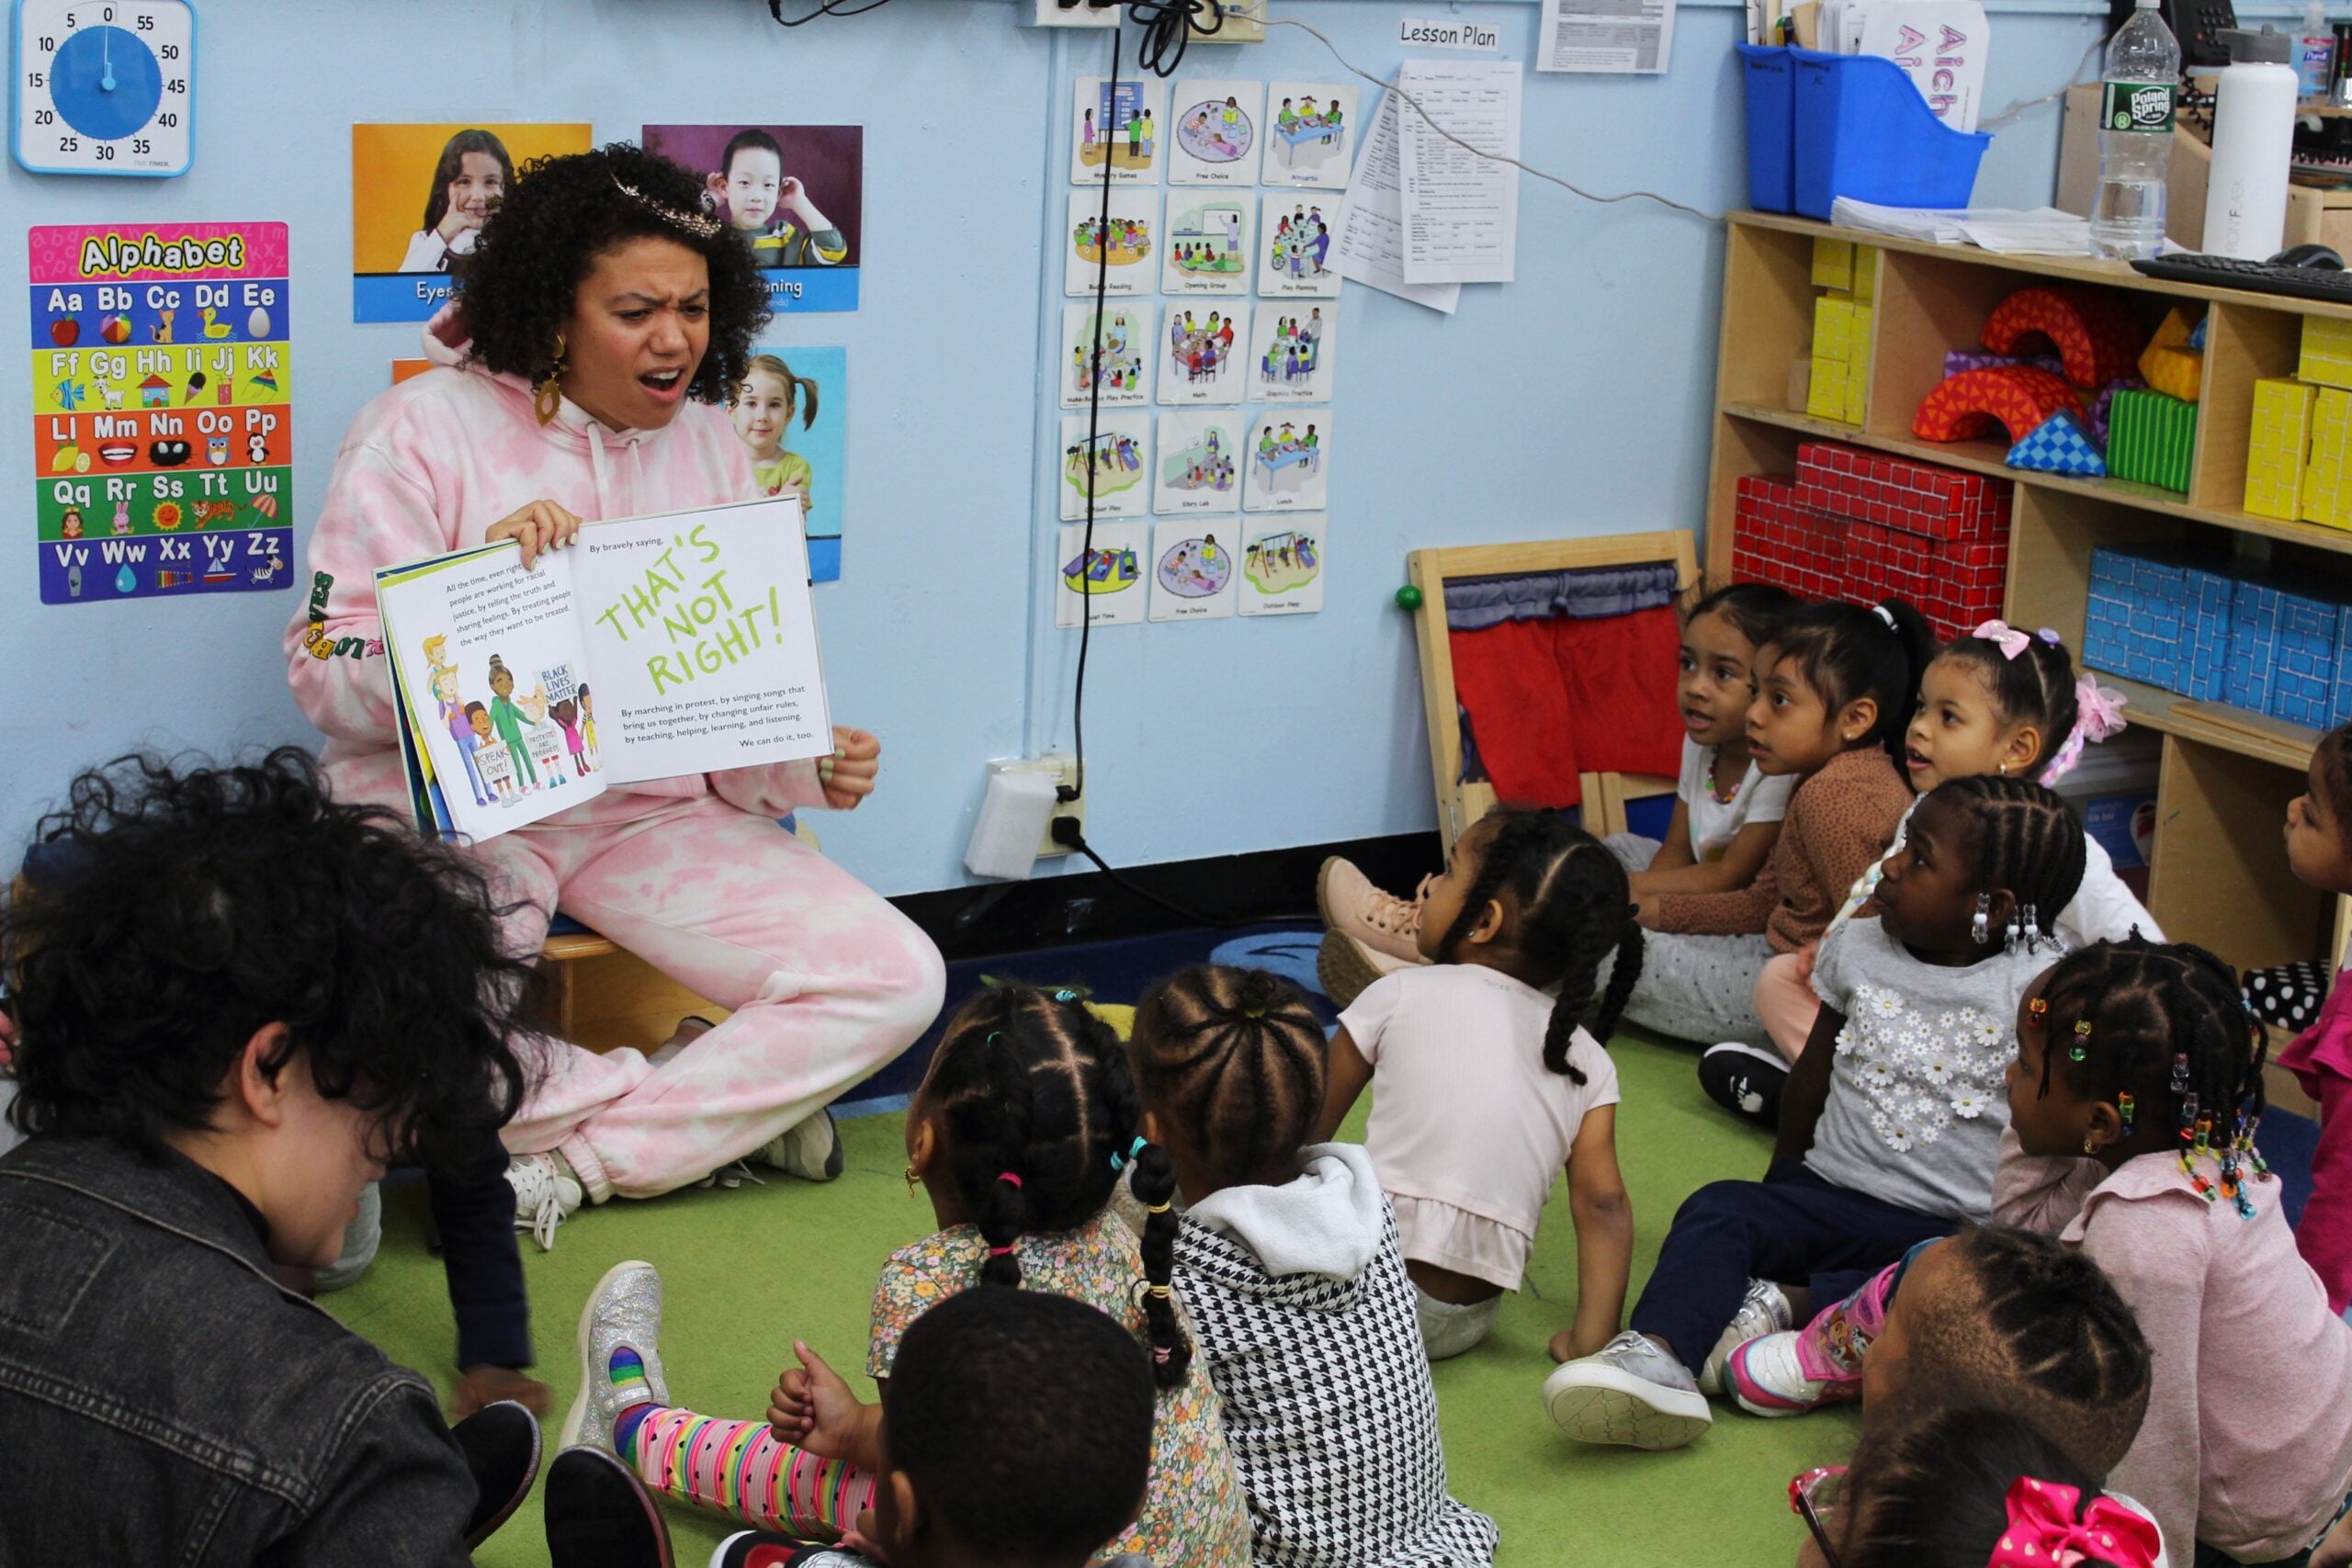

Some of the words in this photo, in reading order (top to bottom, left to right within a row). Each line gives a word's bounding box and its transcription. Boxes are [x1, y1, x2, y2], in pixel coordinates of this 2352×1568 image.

[66, 13, 75, 28] 5
[103, 7, 113, 22] 0
[138, 16, 154, 30] 55
[1400, 22, 1458, 44] Lesson
[1463, 26, 1496, 46] Plan
[39, 37, 54, 51] 10
[162, 46, 179, 60] 50
[28, 73, 44, 88] 15
[167, 79, 186, 94] 45
[2132, 86, 2170, 107] Poland
[34, 110, 53, 125] 20
[2132, 101, 2170, 119] Spring
[158, 113, 177, 128] 40
[60, 138, 78, 152] 25
[96, 146, 114, 161] 30
[132, 140, 151, 154] 35
[83, 235, 243, 274] Alphabet
[1184, 281, 1207, 290] Opening
[48, 288, 83, 312] Aa
[97, 287, 133, 310] Bb
[146, 285, 181, 310] Cc
[195, 284, 230, 309] Dd
[243, 283, 276, 307] Ee
[51, 351, 80, 377] Ff
[89, 351, 127, 380] Gg
[136, 349, 172, 374] Hh
[186, 347, 202, 372] Ii
[211, 347, 235, 376] Jj
[246, 345, 279, 369] Kk
[51, 415, 77, 441] Ll
[94, 415, 138, 439] Mm
[149, 412, 184, 437] Nn
[197, 410, 233, 434] Oo
[244, 408, 277, 437] Pp
[53, 479, 91, 509] Qq
[106, 478, 137, 502] Rr
[153, 476, 184, 499] Ss
[198, 472, 229, 496] Tt
[244, 470, 277, 494] Uu
[55, 543, 89, 568] Vv
[101, 540, 147, 564] Ww
[158, 537, 191, 560] Xx
[202, 535, 235, 562] Yy
[246, 533, 280, 556] Zz
[589, 545, 601, 553] By
[603, 540, 633, 553] bravely
[636, 536, 663, 548] saying,
[447, 585, 456, 593] All
[458, 581, 469, 590] the
[470, 576, 488, 586] time,
[489, 570, 505, 580] even
[505, 563, 522, 574] right
[595, 524, 720, 641] THAT'S
[448, 593, 472, 608] people
[485, 581, 514, 595] working
[514, 577, 525, 585] for
[526, 570, 546, 581] racial
[452, 608, 476, 622] justice,
[478, 604, 486, 614] by
[487, 595, 509, 608] telling
[509, 593, 522, 602] the
[523, 586, 542, 597] truth
[544, 581, 556, 591] and
[662, 569, 733, 644] NOT
[456, 619, 482, 634] sharing
[481, 611, 510, 625] feelings.
[511, 606, 520, 616] By
[522, 597, 549, 610] treating
[551, 590, 571, 604] people
[459, 637, 472, 647] the
[473, 632, 488, 642] way
[489, 626, 504, 637] they
[505, 620, 524, 631] want
[525, 617, 534, 626] to
[535, 613, 544, 622] be
[545, 604, 570, 618] treated.
[647, 586, 783, 696] RIGHT!
[541, 664, 569, 682] BLACK
[546, 674, 571, 692] LIVES
[546, 683, 577, 702] MATTER
[621, 709, 632, 718] By
[634, 705, 673, 716] marching
[675, 702, 684, 710] in
[685, 697, 718, 710] protest,
[720, 695, 730, 705] by
[732, 692, 761, 703] singing
[763, 689, 786, 698] songs
[788, 685, 805, 694] that
[623, 720, 645, 731] bring
[647, 719, 656, 728] us
[658, 715, 696, 728] together,
[698, 712, 709, 722] by
[711, 706, 748, 718] changing
[750, 703, 774, 713] unfair
[775, 700, 799, 709] rules,
[625, 735, 636, 744] by
[638, 731, 674, 742] teaching,
[676, 726, 709, 737] helping,
[711, 721, 746, 732] learning,
[749, 718, 764, 728] and
[765, 713, 802, 724] listening.
[740, 739, 754, 748] We
[757, 738, 772, 746] can
[774, 735, 785, 743] do
[786, 734, 796, 742] it,
[797, 731, 814, 739] too.
[480, 748, 510, 766] SPEAK
[487, 759, 509, 775] OUT!
